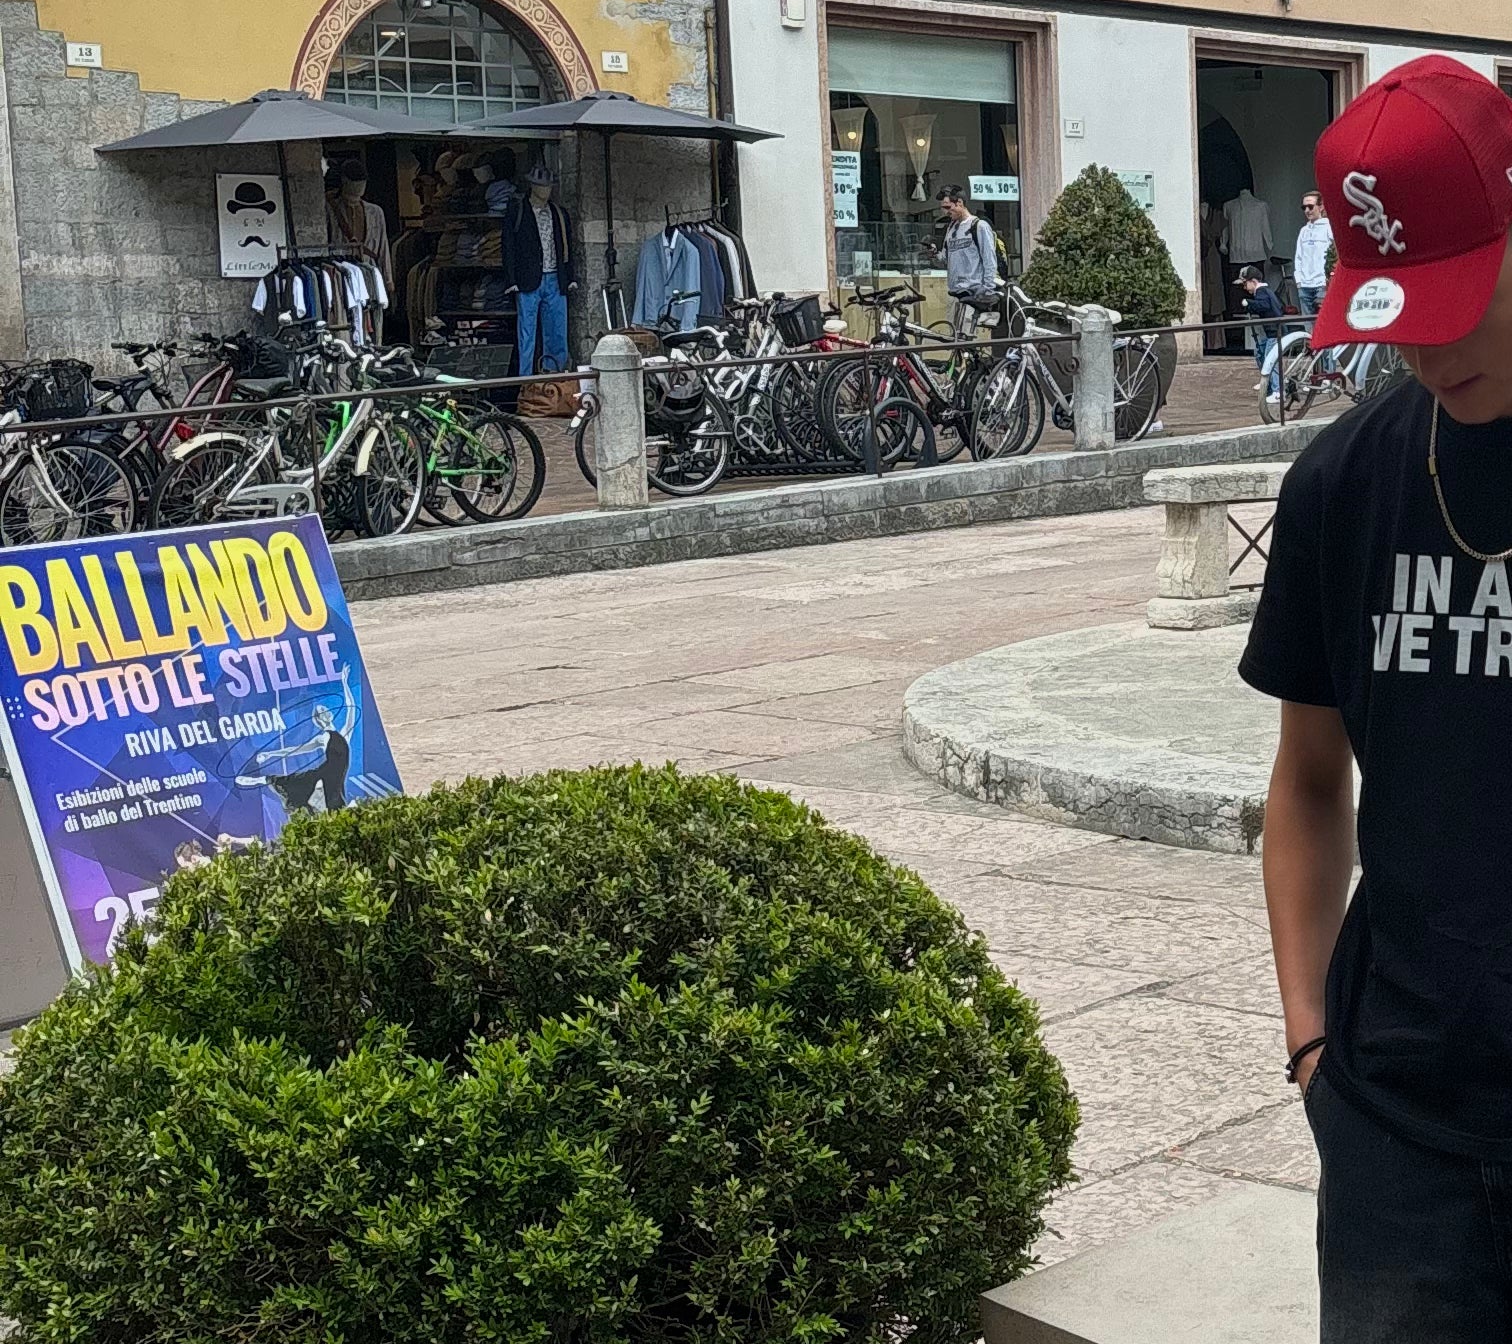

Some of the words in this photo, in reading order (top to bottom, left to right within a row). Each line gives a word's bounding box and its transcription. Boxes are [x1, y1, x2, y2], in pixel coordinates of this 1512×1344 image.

[79, 47, 92, 57] 13
[0, 531, 328, 676] BALLANDO
[1392, 553, 1453, 614] IN
[24, 663, 160, 731] SOTTO
[161, 654, 215, 709] LE
[218, 633, 344, 698] STELLE
[125, 727, 177, 758] RIVA
[178, 720, 218, 748] DEL
[218, 708, 287, 741] GARDA
[55, 783, 125, 811] Esibizioni
[127, 776, 161, 798] delle
[163, 767, 207, 790] scuole
[64, 815, 79, 833] di
[80, 809, 118, 830] ballo
[120, 804, 143, 823] del
[143, 794, 203, 817] Trentino
